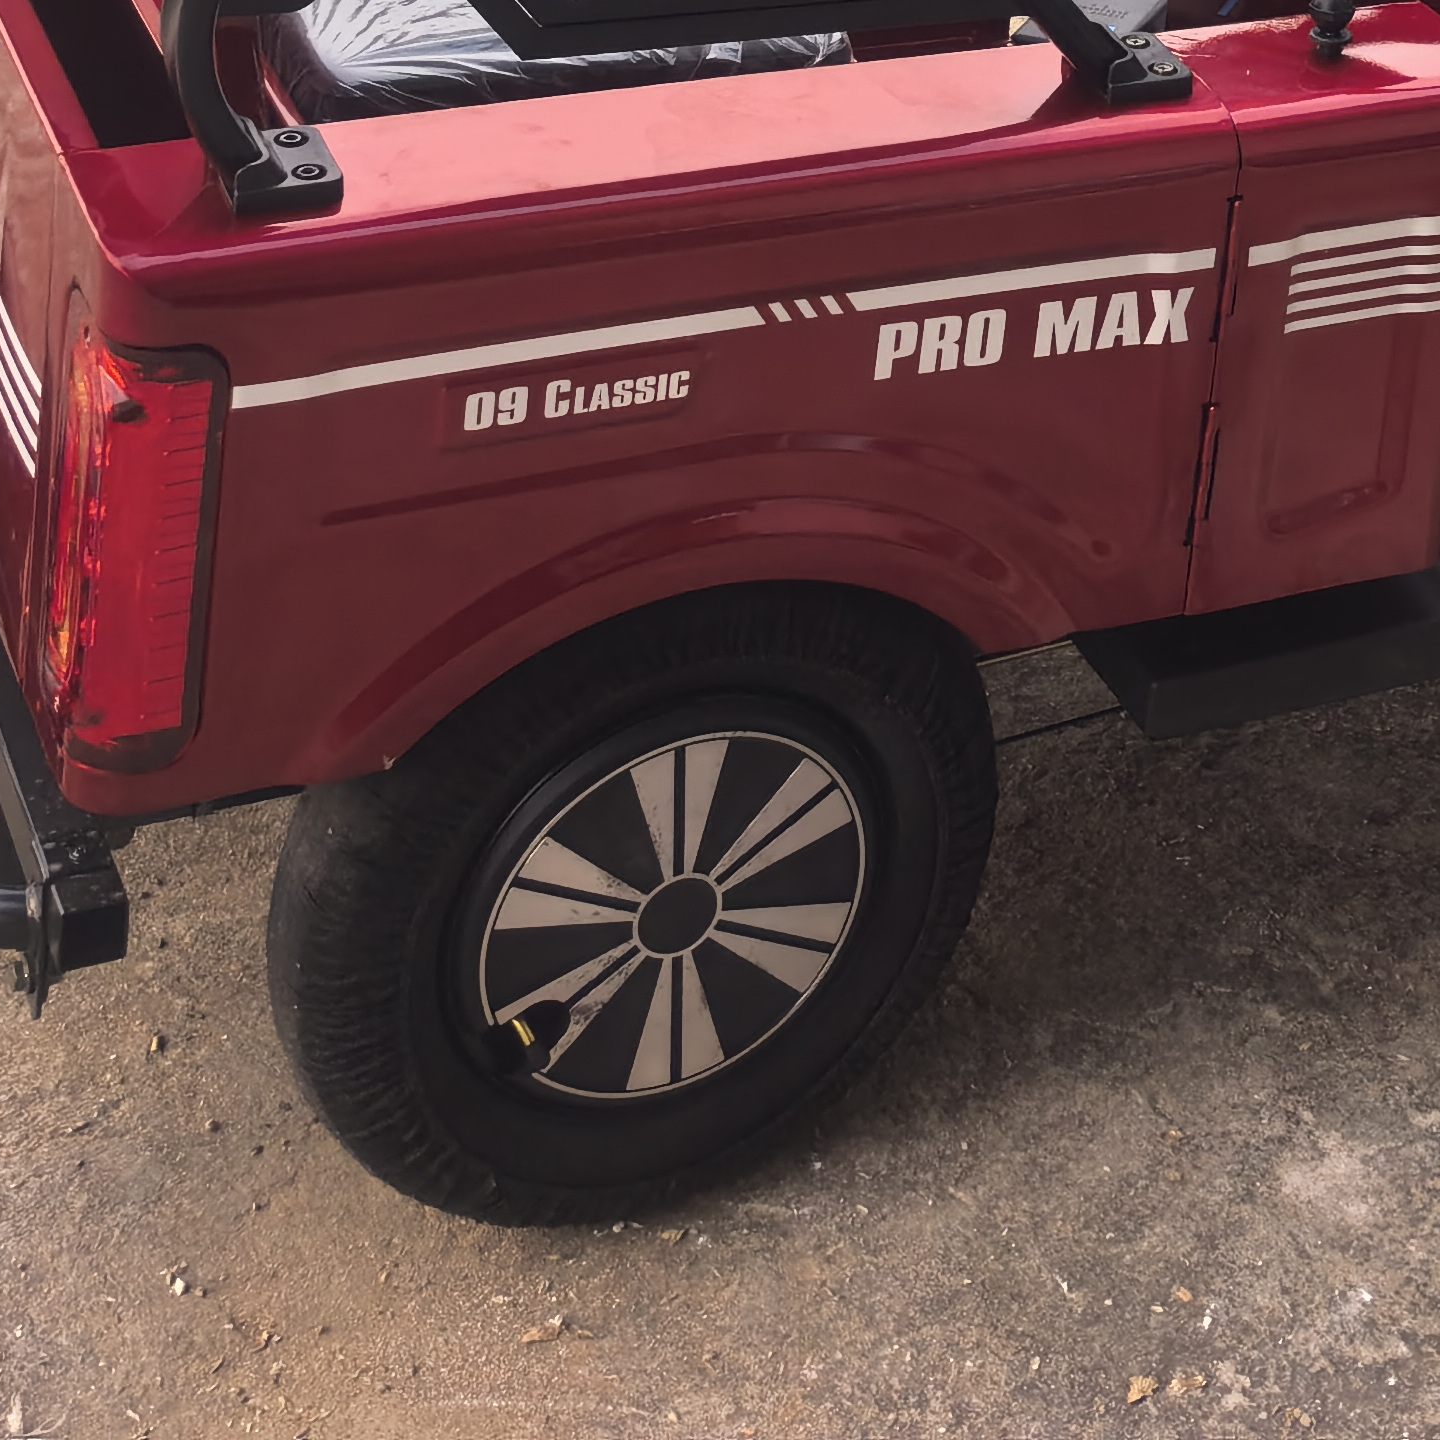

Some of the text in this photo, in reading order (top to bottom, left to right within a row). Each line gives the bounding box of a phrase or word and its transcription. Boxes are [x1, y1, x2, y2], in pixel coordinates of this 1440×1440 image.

[873, 286, 1196, 381] PRO MAX
[463, 386, 529, 431] 09
